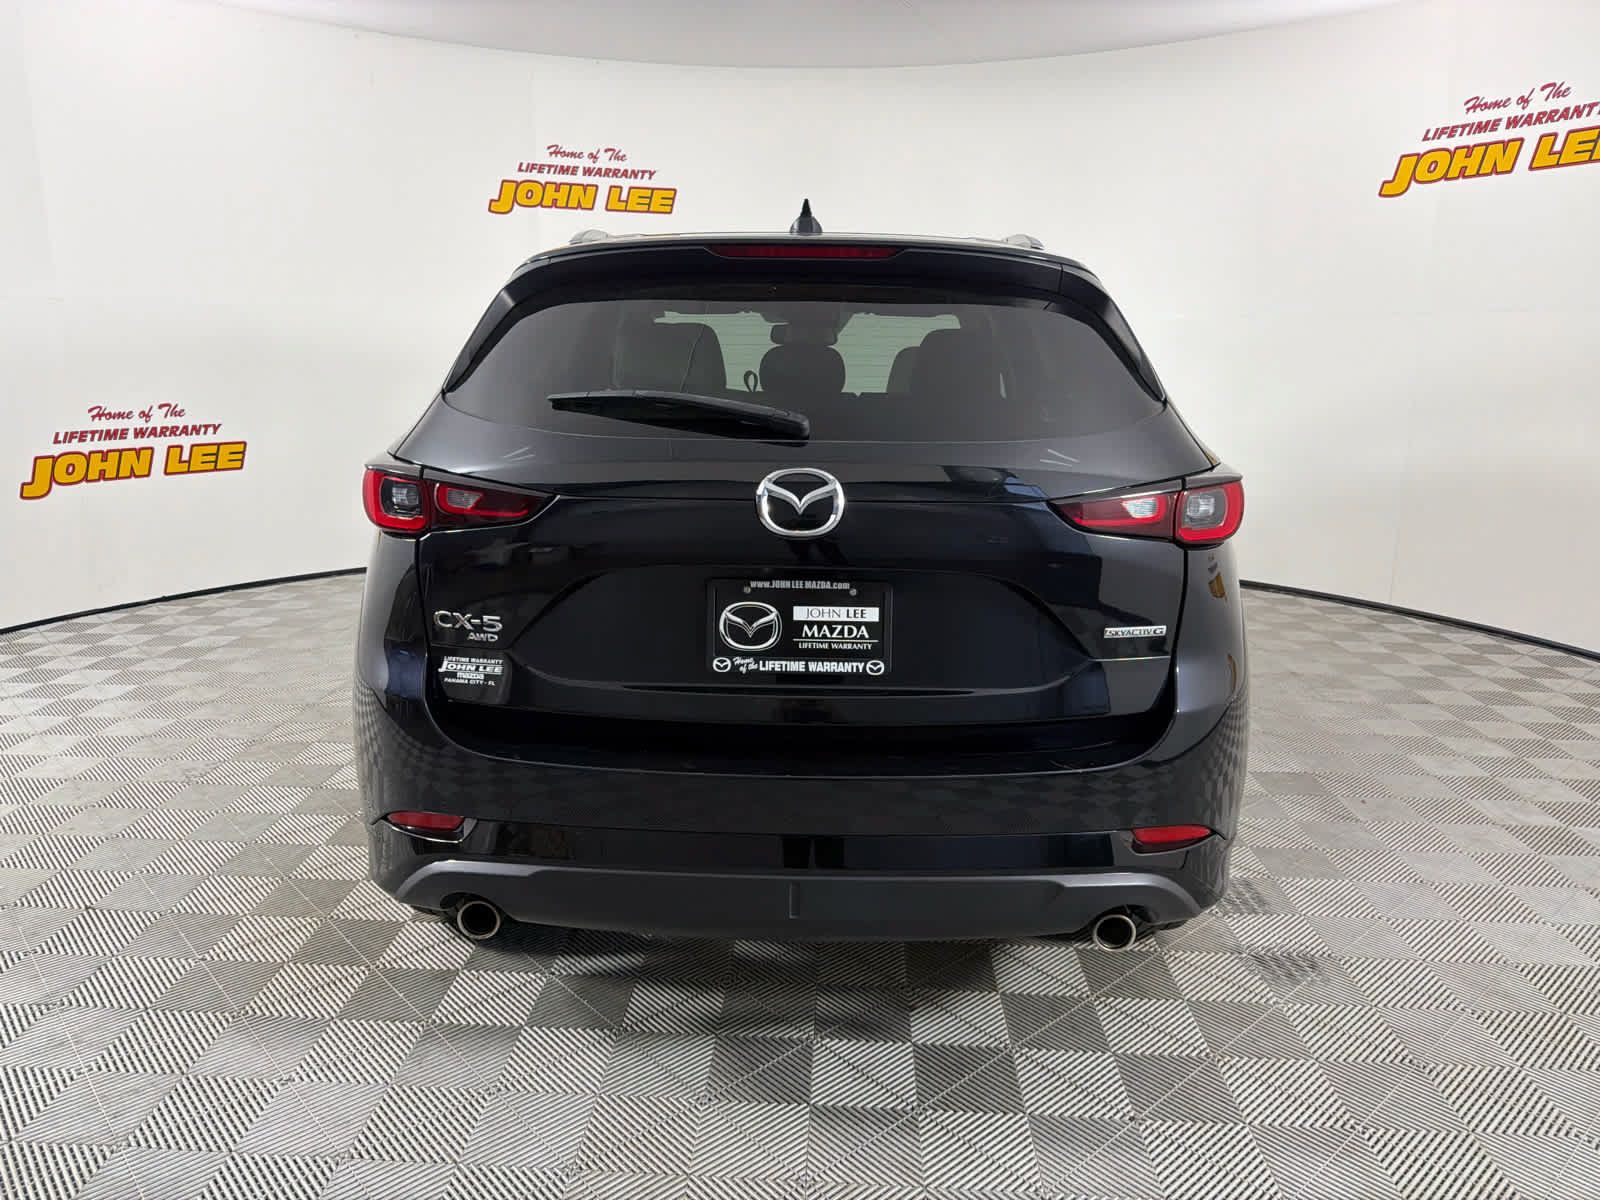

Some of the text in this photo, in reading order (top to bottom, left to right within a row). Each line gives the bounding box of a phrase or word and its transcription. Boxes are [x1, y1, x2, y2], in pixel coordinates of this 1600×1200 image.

[1464, 81, 1571, 114] Home of The
[1422, 101, 1600, 142] LIFETIME WARRANT
[547, 144, 627, 164] Home of The
[1378, 125, 1600, 198] JOHN LE
[517, 162, 656, 180] LIFETIME WARRANTY
[488, 179, 677, 214] JOHN LEE
[88, 403, 185, 423] Home of The
[53, 423, 222, 444] LIFETIME WARRANTY
[20, 441, 247, 500] JOHN LEE
[433, 610, 503, 632] CX-5
[806, 608, 867, 619] JOHN LEE
[467, 632, 499, 642] AWD
[802, 625, 869, 638] MAZDA
[438, 660, 504, 673] JOHN LEE
[759, 660, 865, 673] LIFETIME WARRANTY
